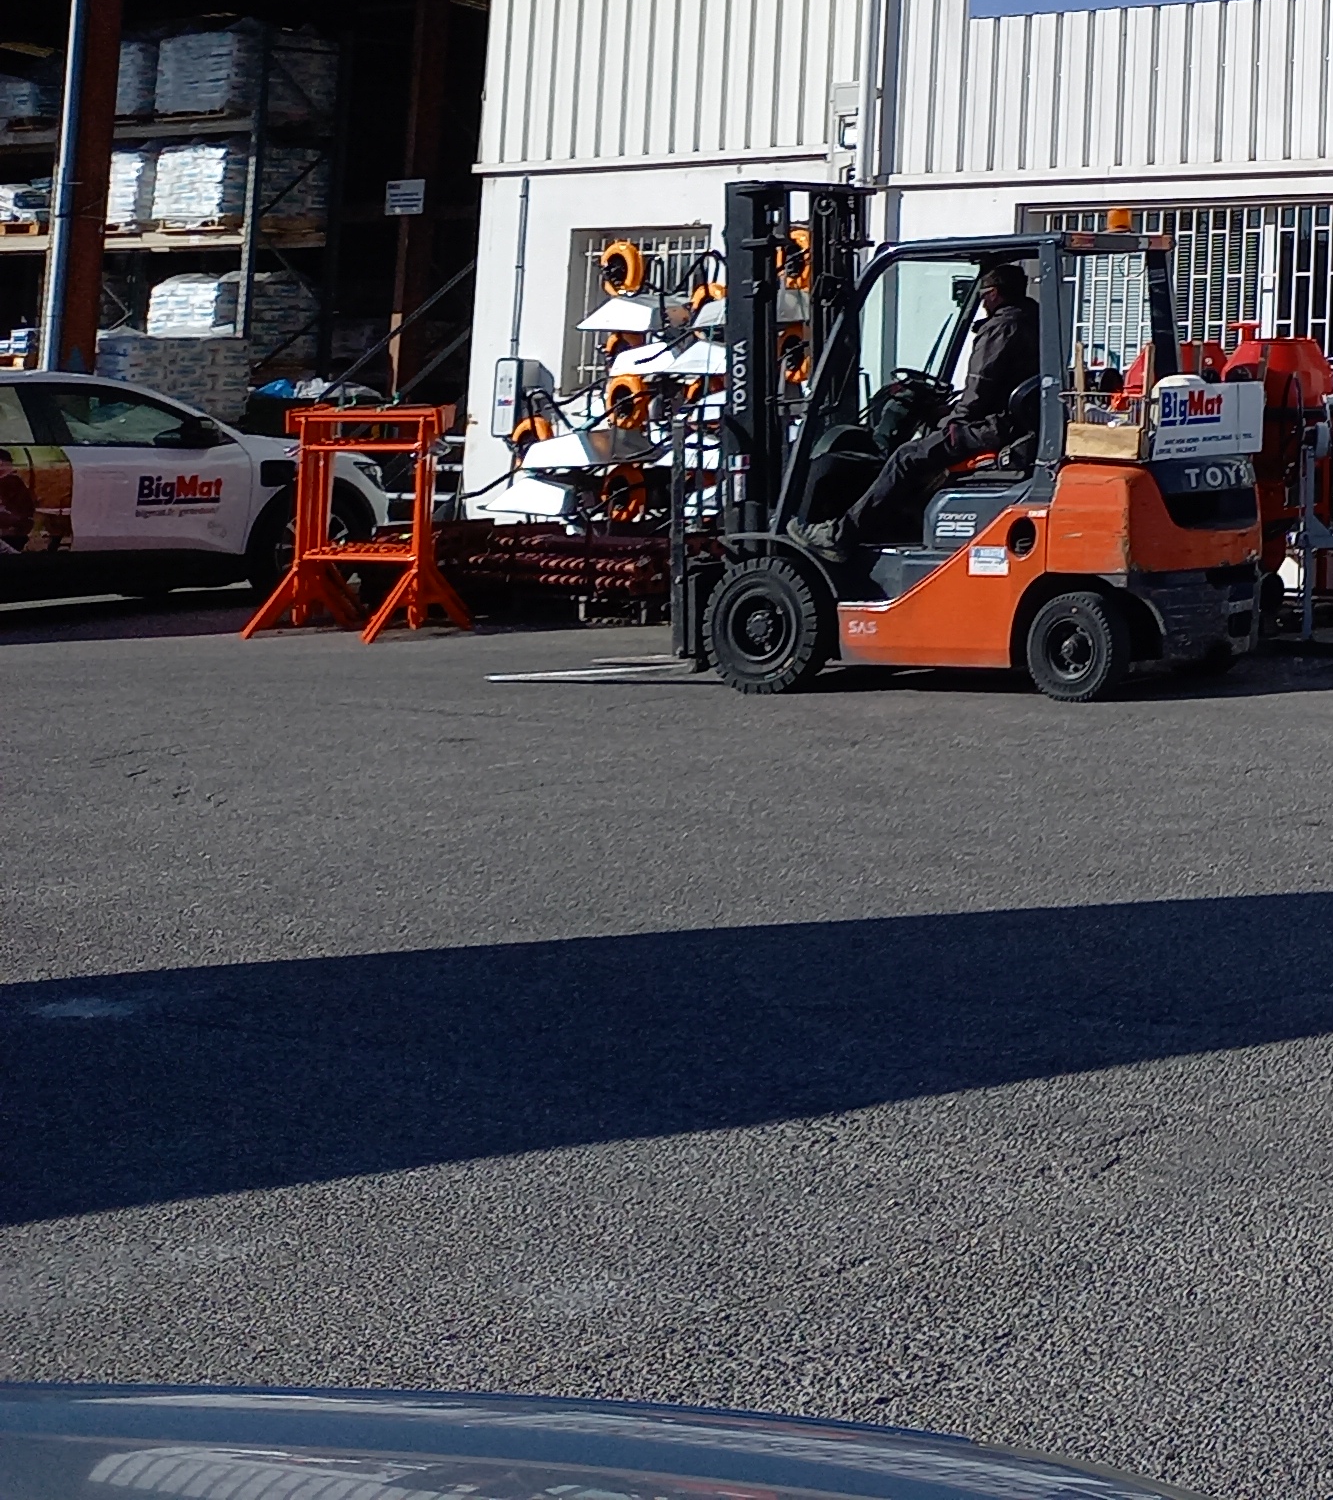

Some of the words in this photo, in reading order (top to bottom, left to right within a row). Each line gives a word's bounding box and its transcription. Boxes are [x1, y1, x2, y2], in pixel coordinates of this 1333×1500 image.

[733, 339, 748, 415] TOYOTA
[1161, 389, 1224, 426] BigMat
[138, 474, 223, 505] BigMat
[935, 521, 976, 537] 25
